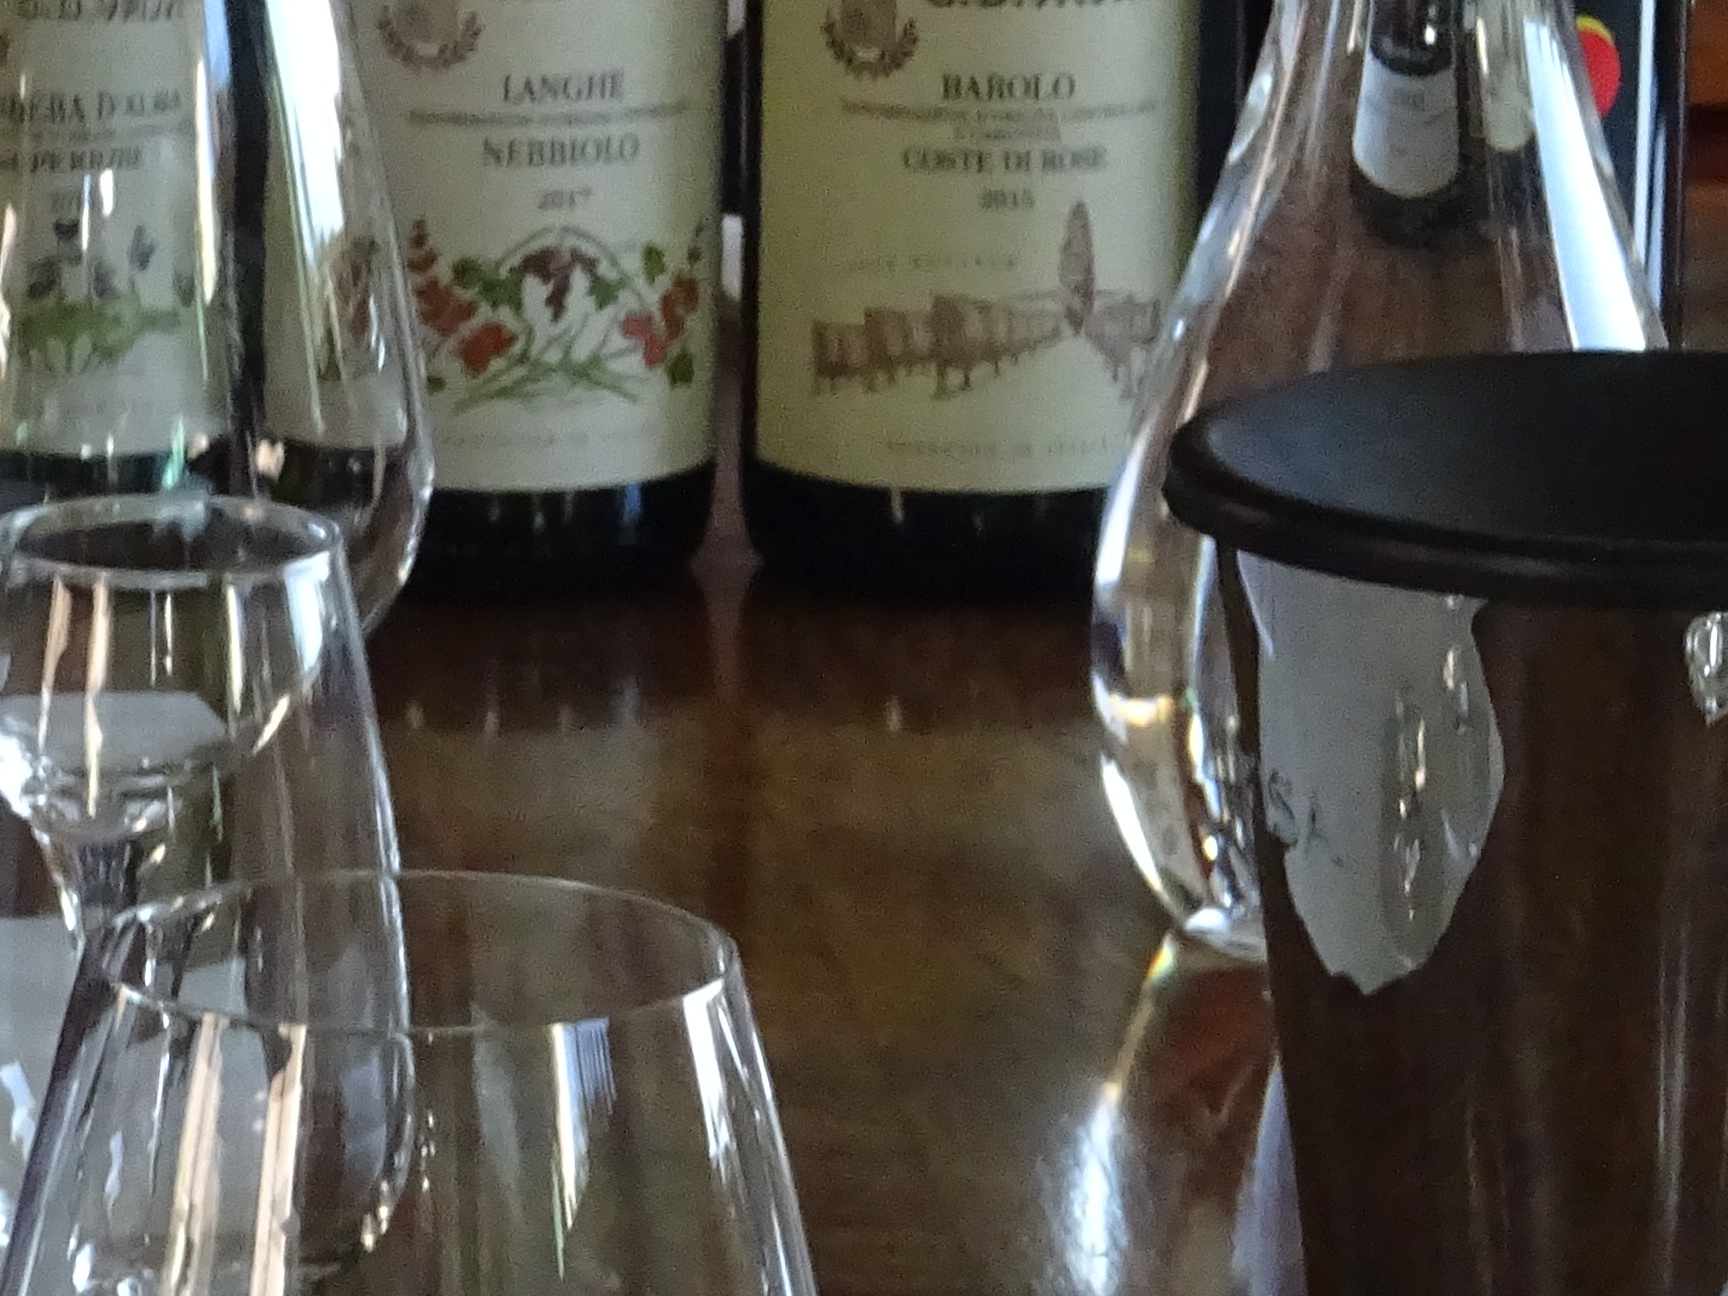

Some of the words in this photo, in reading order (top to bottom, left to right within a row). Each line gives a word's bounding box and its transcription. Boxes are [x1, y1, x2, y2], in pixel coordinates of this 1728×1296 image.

[501, 69, 625, 104] LANGHE
[940, 71, 1076, 103] BAROLO
[482, 132, 641, 168] NEBBIOLO
